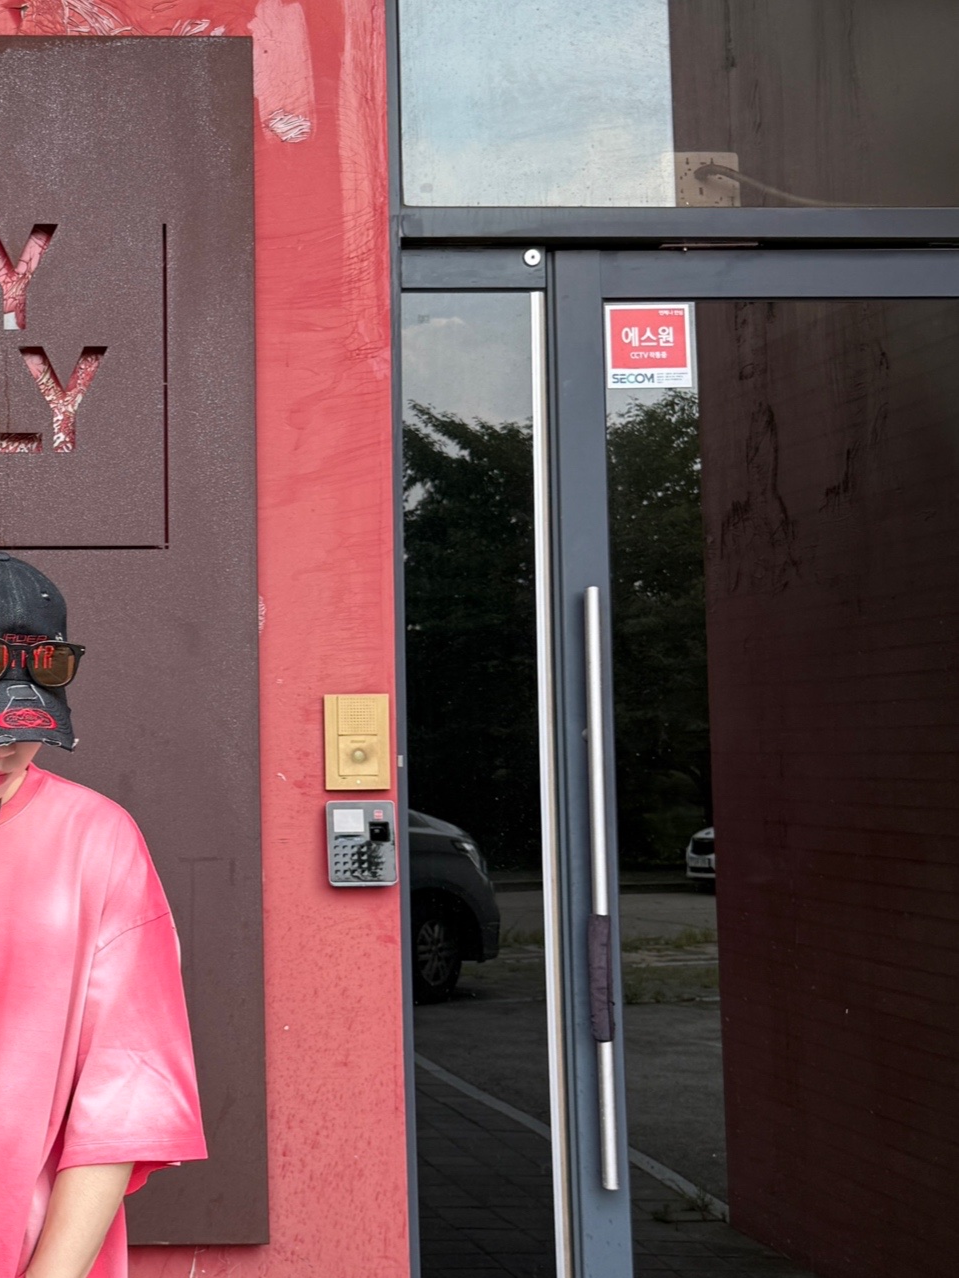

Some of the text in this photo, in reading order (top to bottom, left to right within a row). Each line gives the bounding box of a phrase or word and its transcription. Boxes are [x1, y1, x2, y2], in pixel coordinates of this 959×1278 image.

[621, 326, 674, 347] 에스원
[630, 351, 648, 359] CCTV
[612, 373, 655, 384] SECOM
